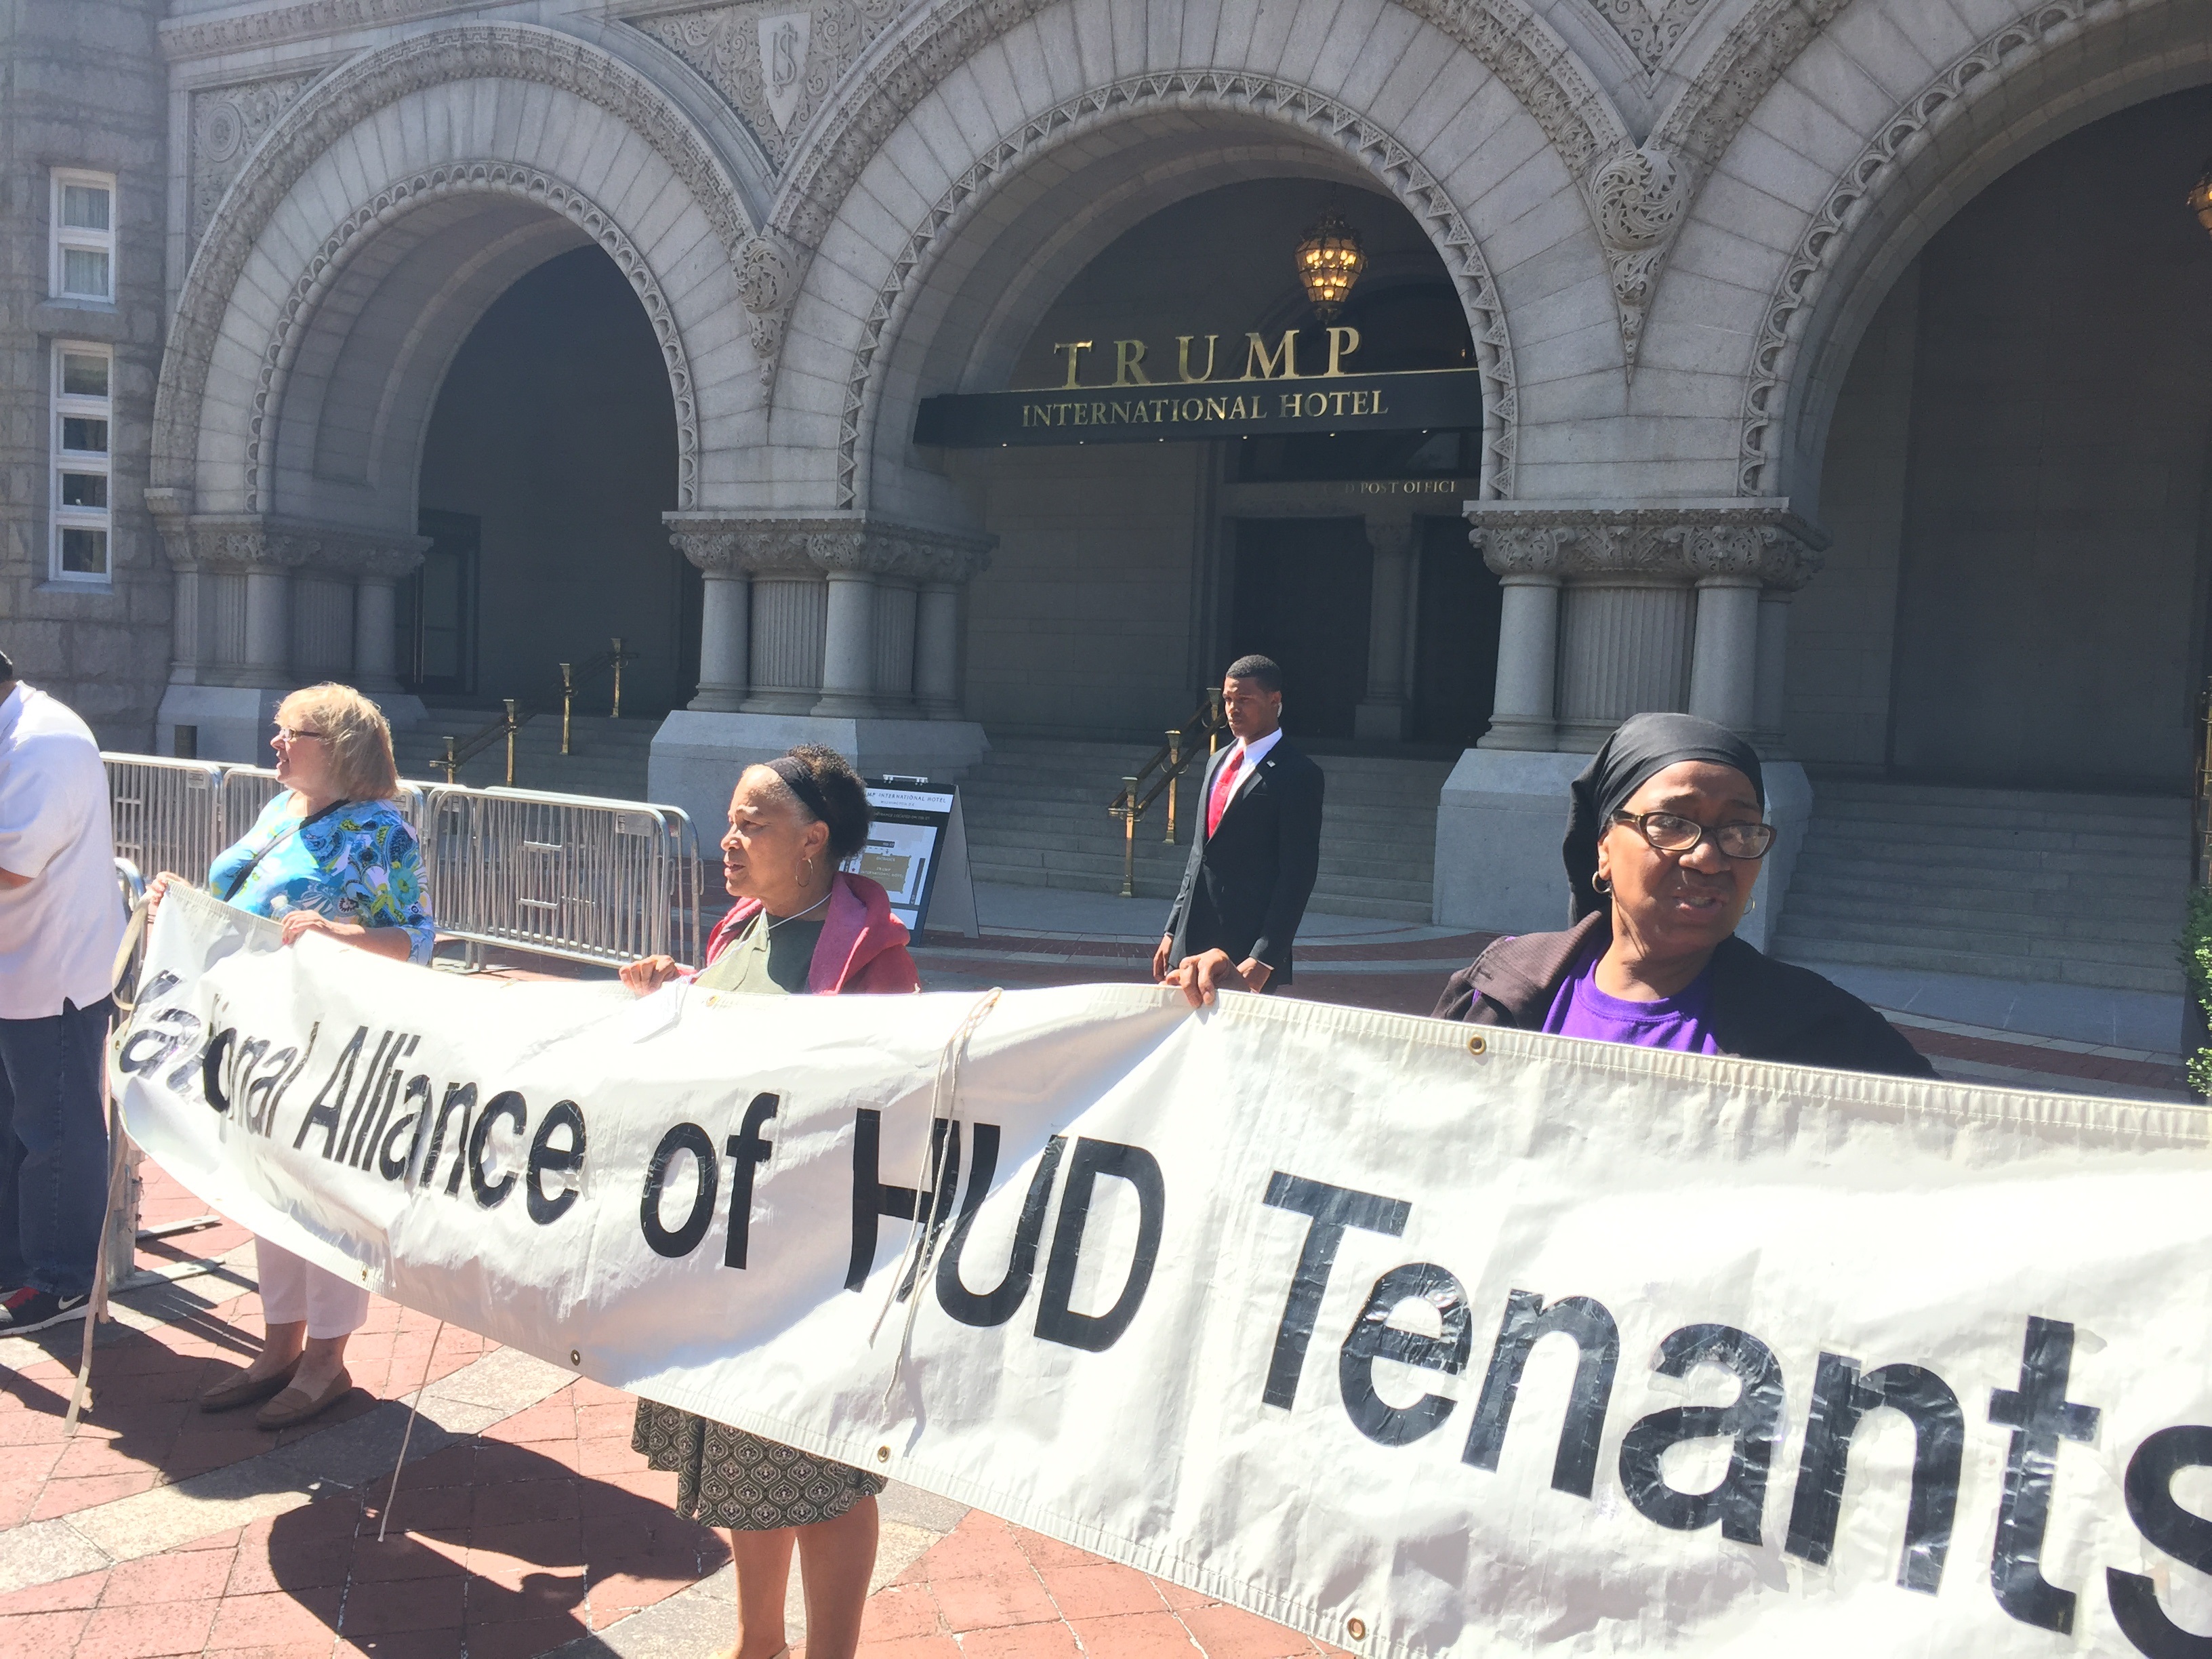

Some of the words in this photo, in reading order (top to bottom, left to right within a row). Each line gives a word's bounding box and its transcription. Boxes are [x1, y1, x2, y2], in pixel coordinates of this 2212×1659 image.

[1054, 327, 1360, 389] TRUMP
[1022, 396, 1267, 427] INTERNATIONAL
[1279, 390, 1389, 418] HOTEL
[1361, 480, 1399, 493] POST
[878, 793, 924, 801] INTERNATIONAL
[293, 1025, 587, 1227] Alliance
[640, 1092, 780, 1269] of
[843, 1107, 1165, 1353] HUD
[1261, 1170, 2212, 1659] Tenants
